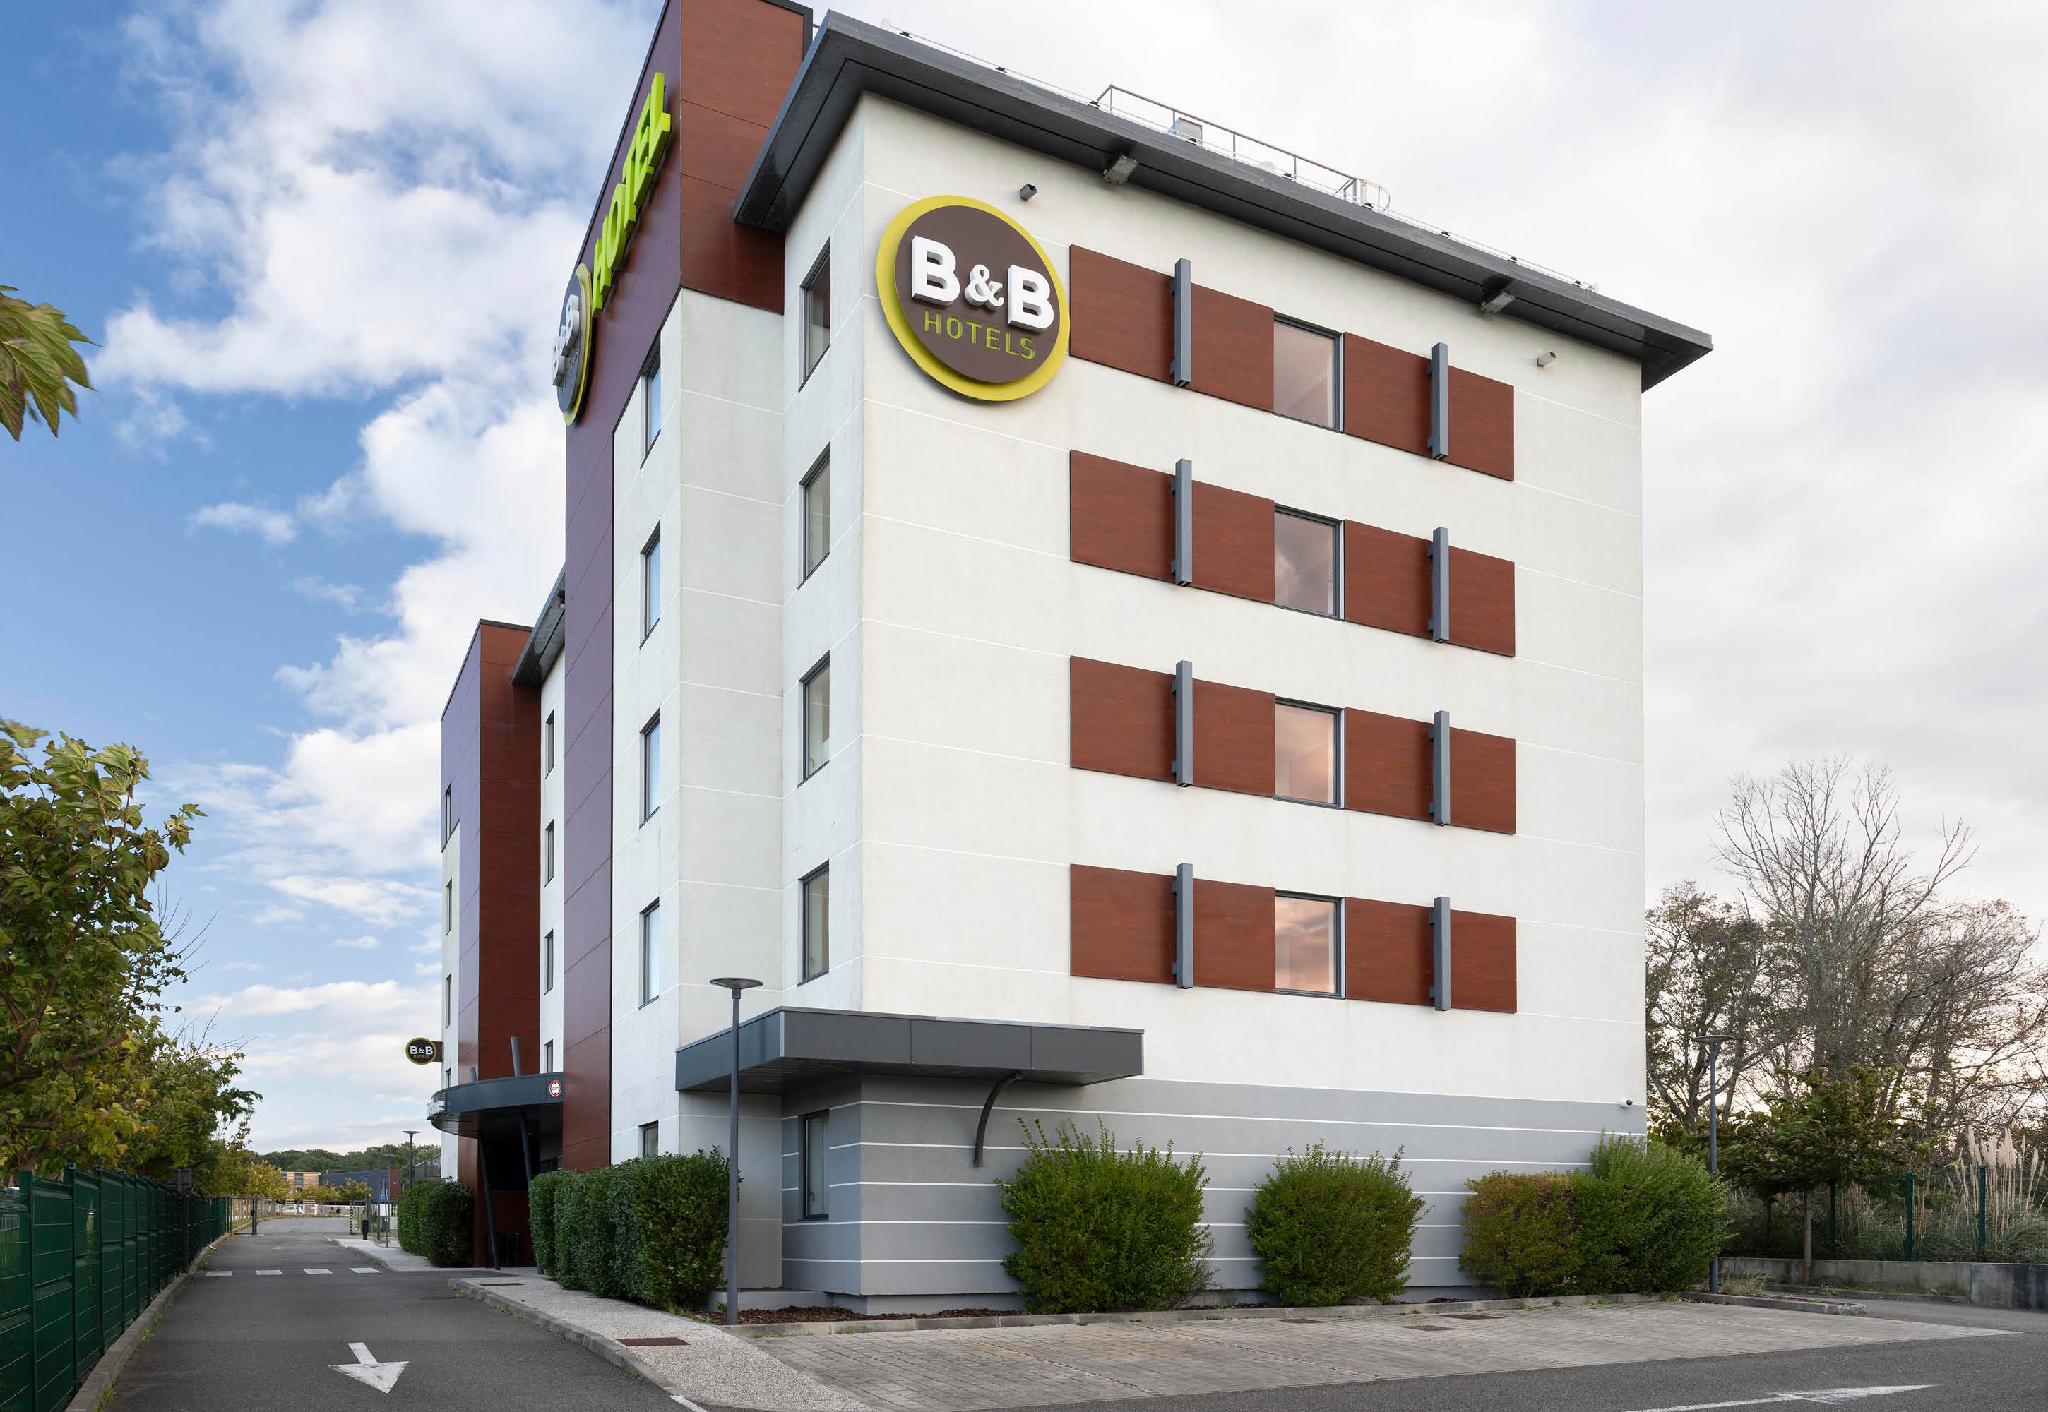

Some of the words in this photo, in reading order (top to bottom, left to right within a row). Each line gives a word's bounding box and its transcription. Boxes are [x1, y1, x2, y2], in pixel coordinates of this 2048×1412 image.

[911, 235, 1054, 333] B&B
[923, 310, 1036, 361] HOTELS
[410, 1045, 434, 1055] B&B
